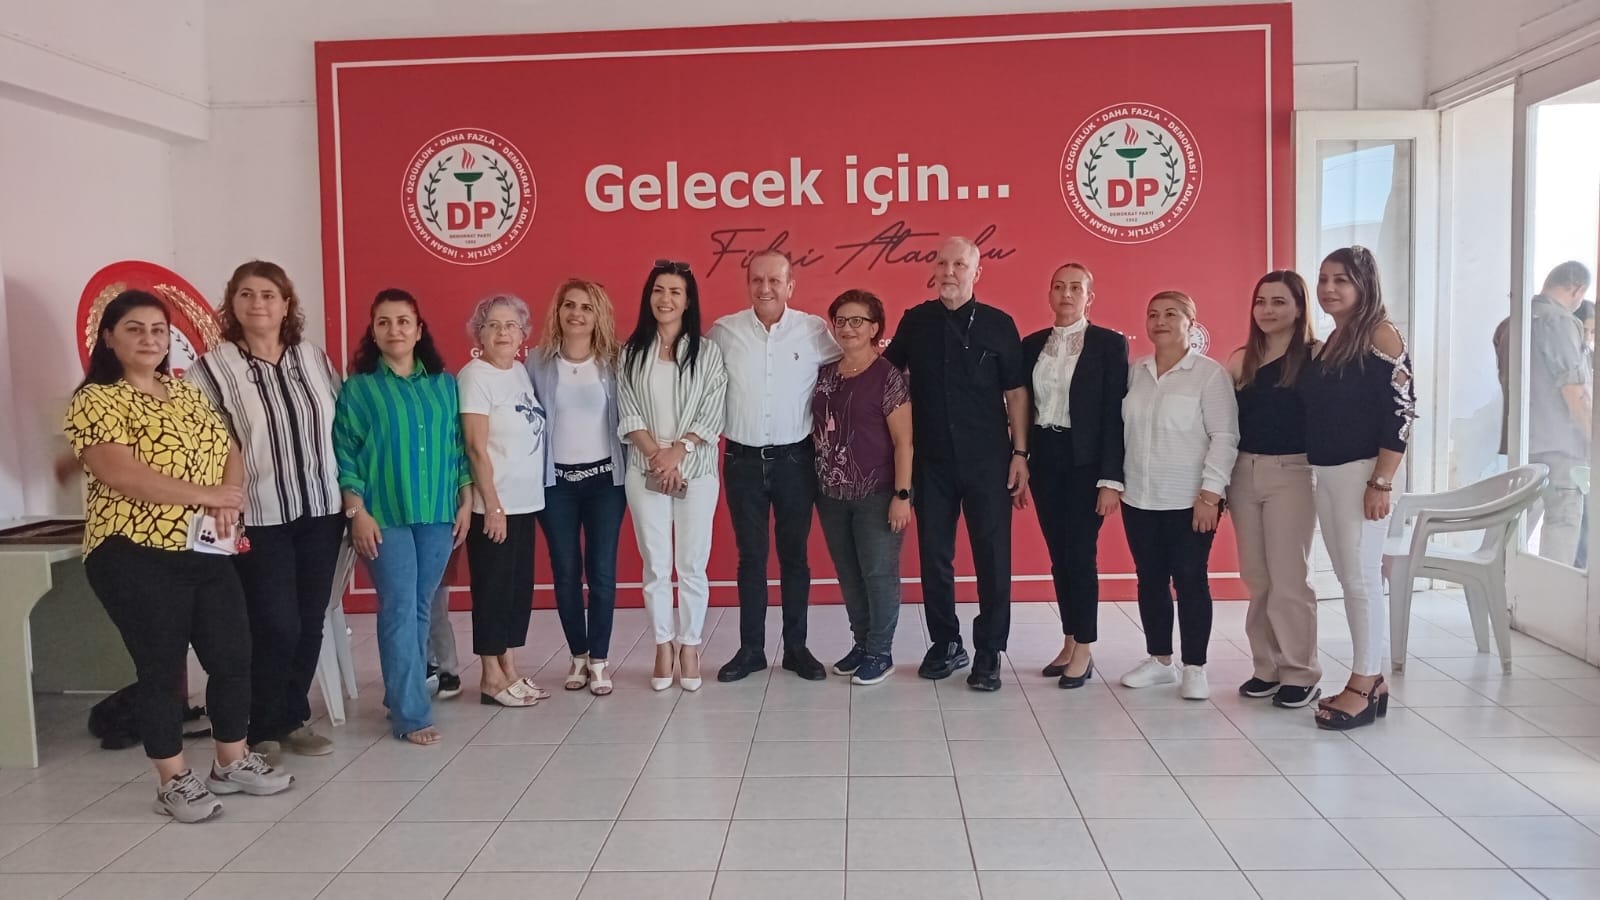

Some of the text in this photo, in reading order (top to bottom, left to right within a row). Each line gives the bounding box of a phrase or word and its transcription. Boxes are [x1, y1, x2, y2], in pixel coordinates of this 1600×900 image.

[440, 133, 465, 146] DAHA
[467, 133, 495, 146] FAZLA
[406, 146, 435, 194] ÖZGÜRLÜK
[502, 146, 532, 198] DEMOKRASİ
[584, 153, 1010, 215] Gelecek için...
[1064, 107, 1198, 238] ÖZGÜRLÜK DAHA FAZLA DEMOKRASİ ADALET EŞİTLİK İNSAN HAKLARI
[1107, 178, 1160, 208] DP
[407, 203, 431, 241] HAKLARI
[447, 201, 496, 231] DP
[508, 207, 529, 240] ADALET
[431, 239, 458, 259] İNSAN
[467, 243, 503, 259] EŞİTLİK
[835, 220, 1016, 289] Ataolu
